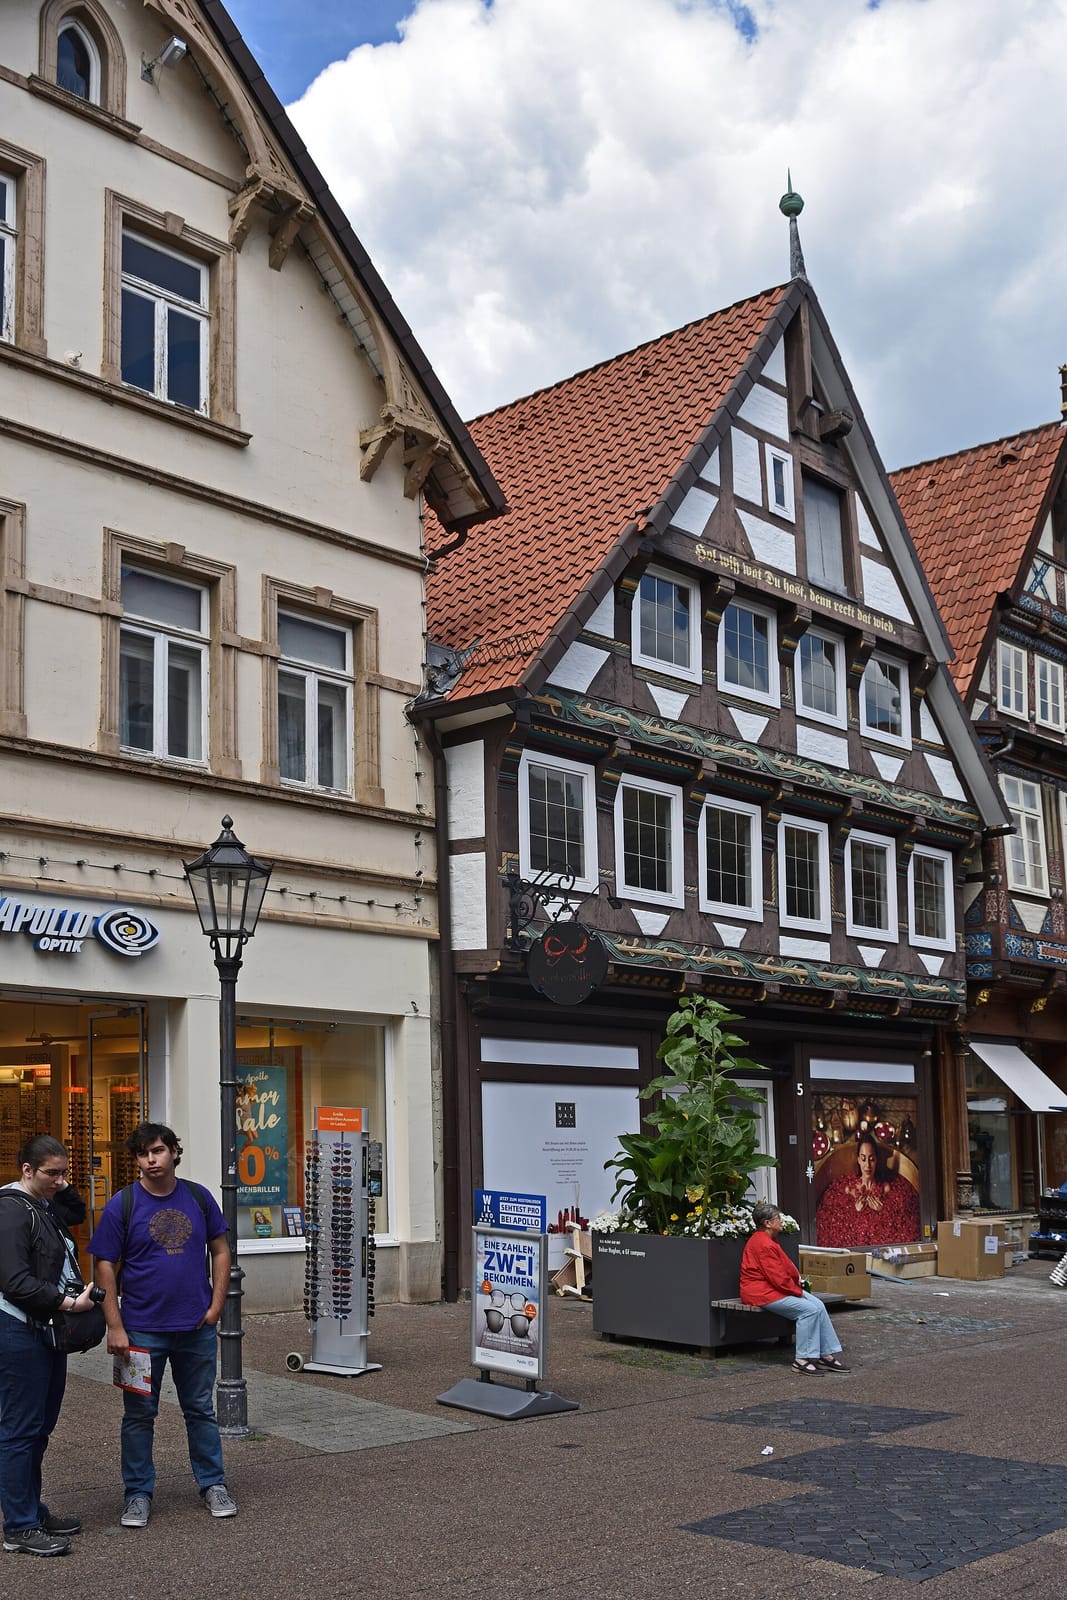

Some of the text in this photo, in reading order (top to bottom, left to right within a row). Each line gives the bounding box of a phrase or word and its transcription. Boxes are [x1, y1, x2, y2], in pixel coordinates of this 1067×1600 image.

[743, 561, 762, 580] wat
[764, 570, 781, 588] Du
[809, 588, 832, 608] denn
[857, 608, 871, 625] dat
[0, 896, 93, 938] APOLLO
[38, 937, 85, 953] OPTIK
[245, 1071, 269, 1085] Apollo
[797, 1083, 804, 1096] 5
[238, 1145, 280, 1186] 0%
[501, 1204, 526, 1213] SEHTEST
[501, 1215, 512, 1223] BEI
[512, 1216, 540, 1226] APOLLO
[484, 1240, 536, 1256] EINE ZAHLEN,
[484, 1250, 533, 1276] ZWEI
[484, 1271, 536, 1288] BEKOMMEN.
